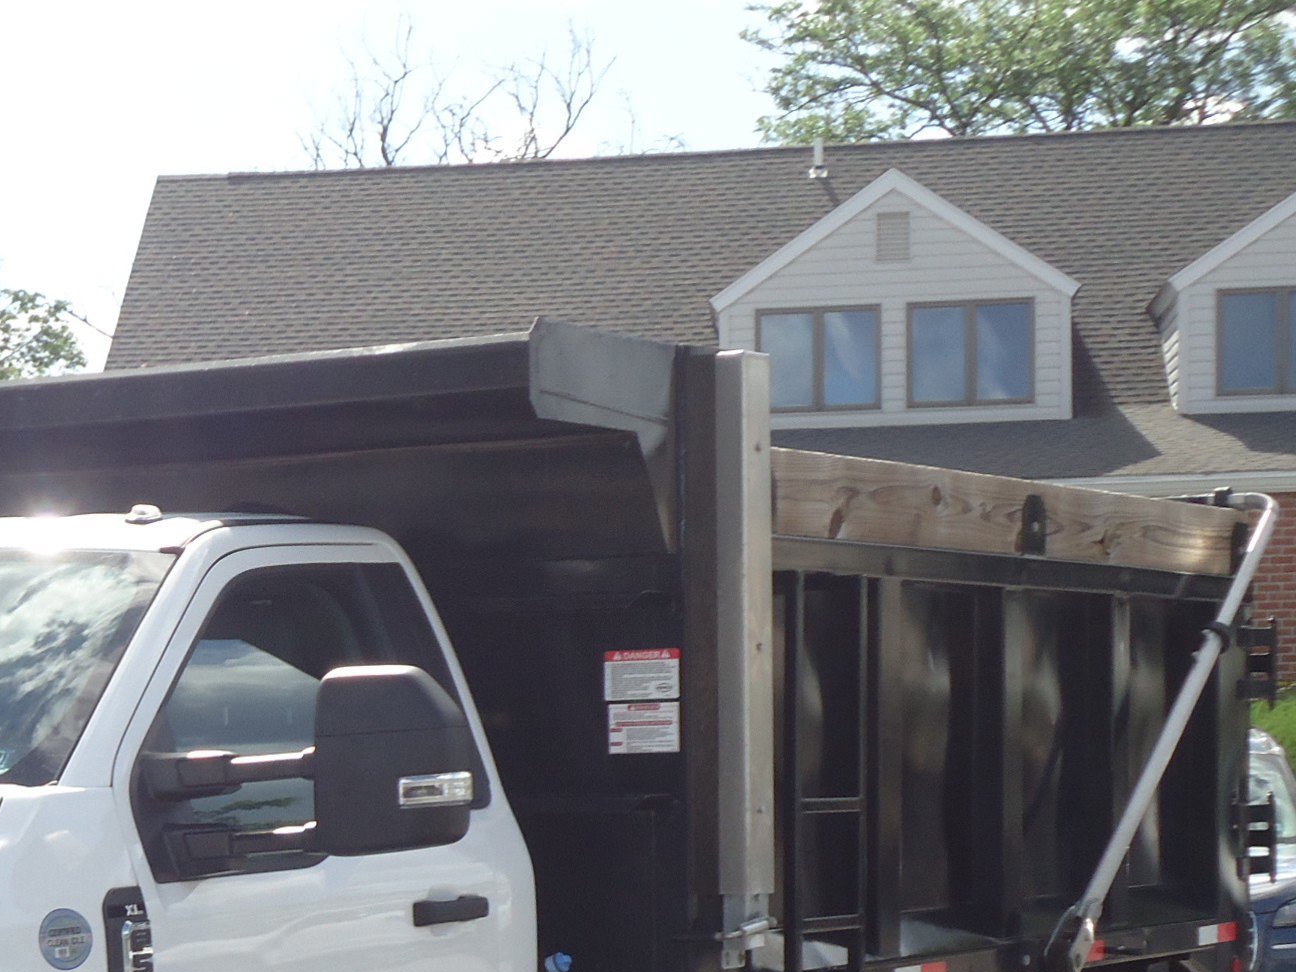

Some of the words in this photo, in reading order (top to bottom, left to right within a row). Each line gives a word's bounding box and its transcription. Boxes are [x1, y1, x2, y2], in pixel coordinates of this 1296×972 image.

[623, 651, 661, 660] DANGER
[125, 904, 144, 917] XL
[48, 927, 81, 937] CERTIFIED
[47, 938, 70, 948] CLEAN
